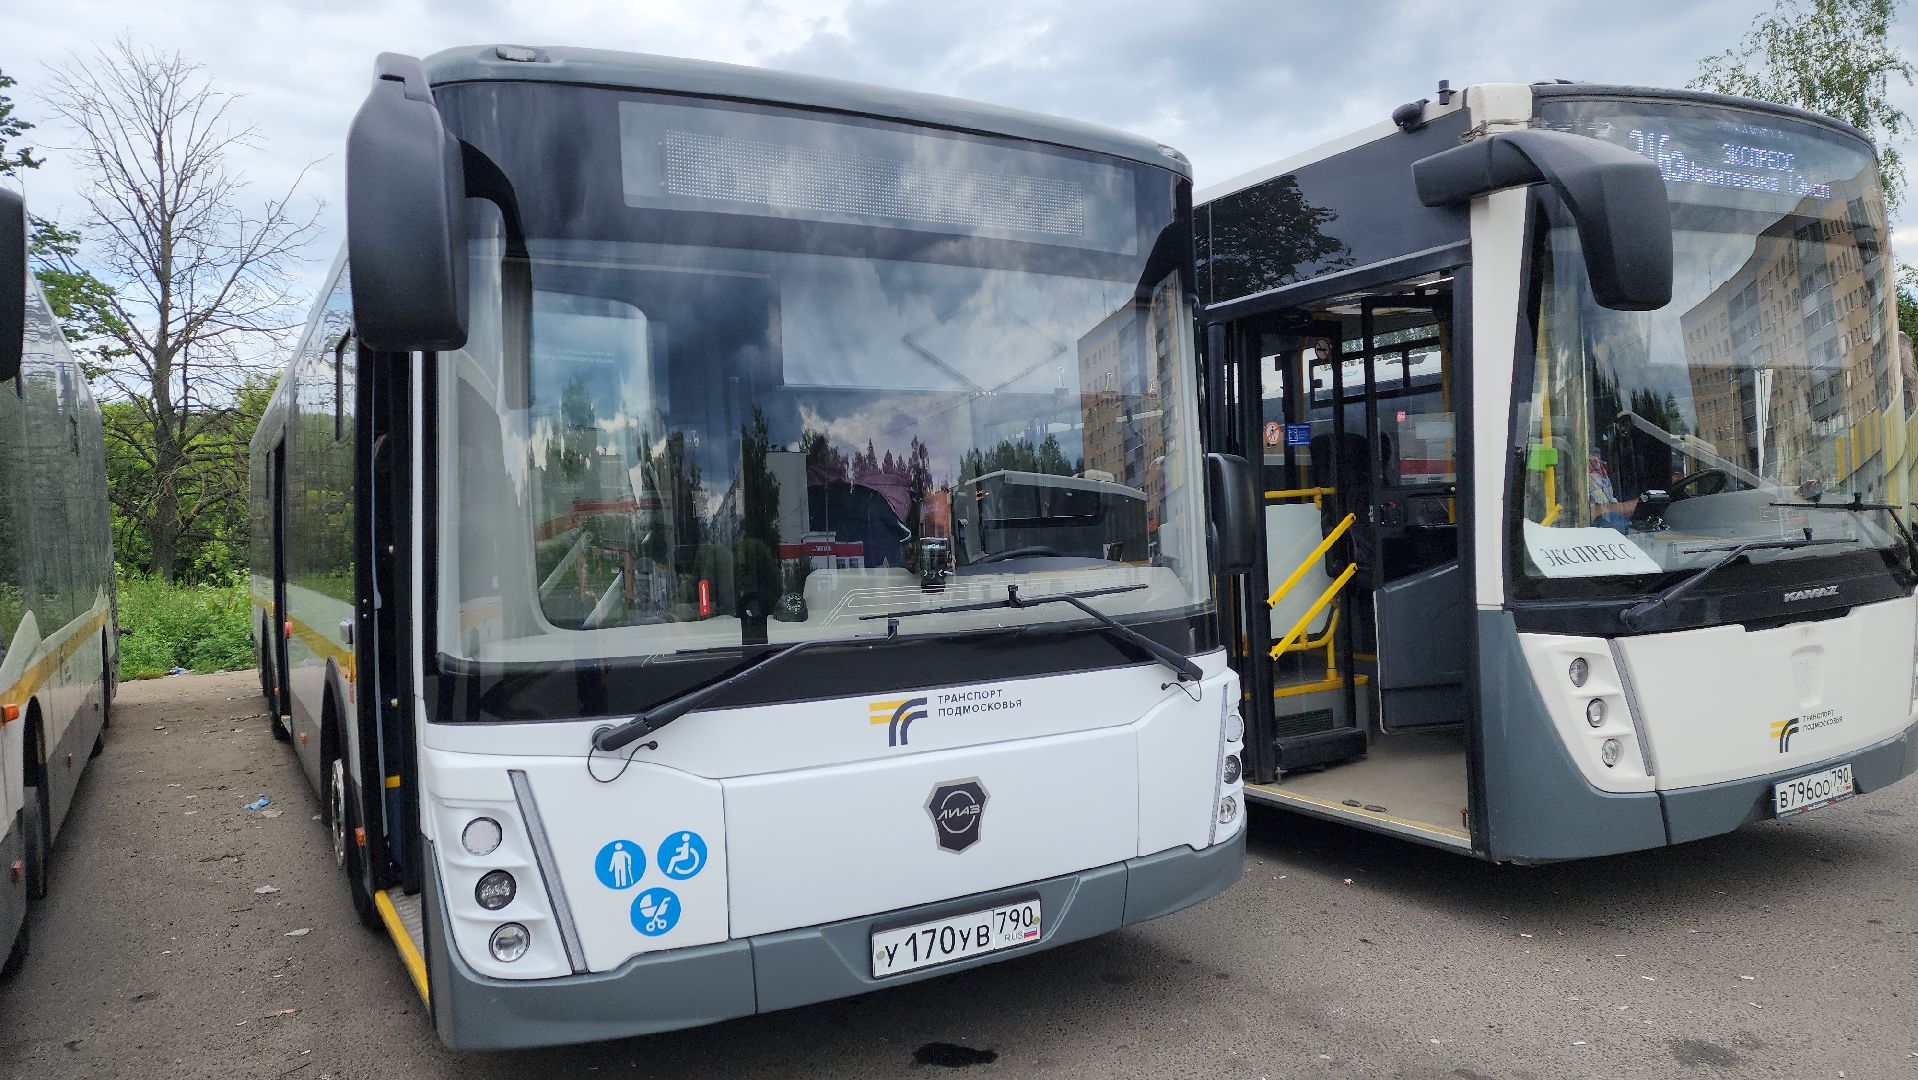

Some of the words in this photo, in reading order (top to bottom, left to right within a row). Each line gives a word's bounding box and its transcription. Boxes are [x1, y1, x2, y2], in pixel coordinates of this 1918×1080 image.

[1539, 543, 1636, 567] ЭКСПРЕСС
[937, 689, 1003, 704] ТРАНСПОРТ
[938, 699, 1022, 717] ПОДМОСКОВЬЯ
[1803, 710, 1834, 722] ТРАНСПОРТ
[1803, 716, 1843, 731] ПОДМОСКОВЬЯ
[1831, 767, 1849, 787] 790
[937, 804, 981, 820] ЛИАЗ
[885, 925, 990, 967] У170УВ
[996, 906, 1034, 934] 790
[1004, 930, 1024, 942] RUS
